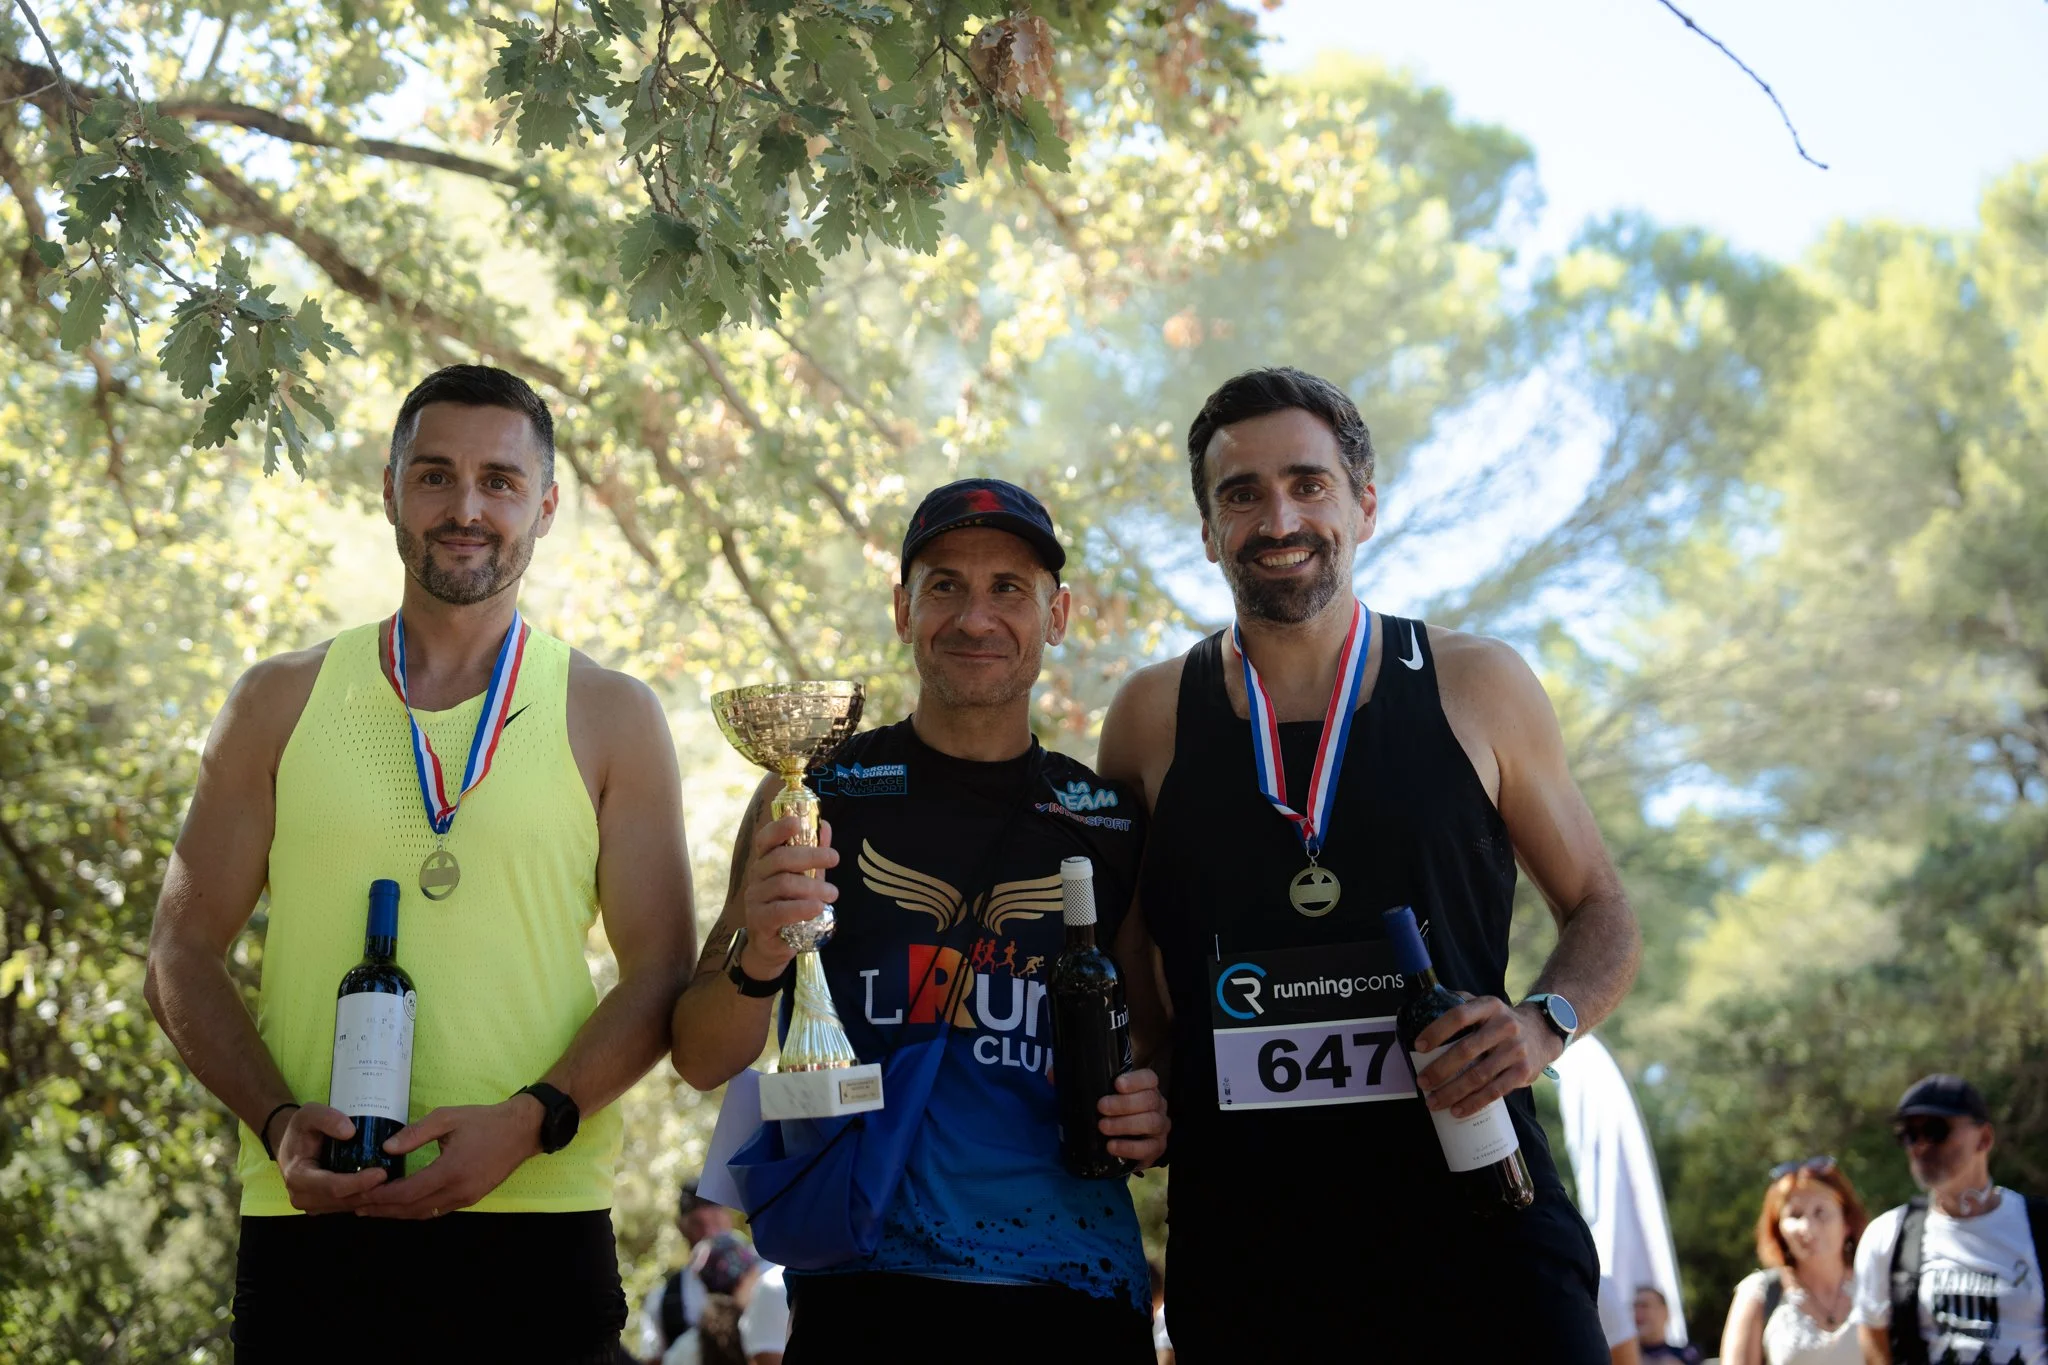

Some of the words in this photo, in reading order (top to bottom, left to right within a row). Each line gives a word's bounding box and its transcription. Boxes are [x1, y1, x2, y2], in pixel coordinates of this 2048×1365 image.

[862, 764, 905, 774] GROUPE
[862, 770, 904, 779] DURAND
[1067, 781, 1090, 794] LA
[1054, 788, 1118, 811] TEAM
[1257, 1030, 1397, 1093] 647
